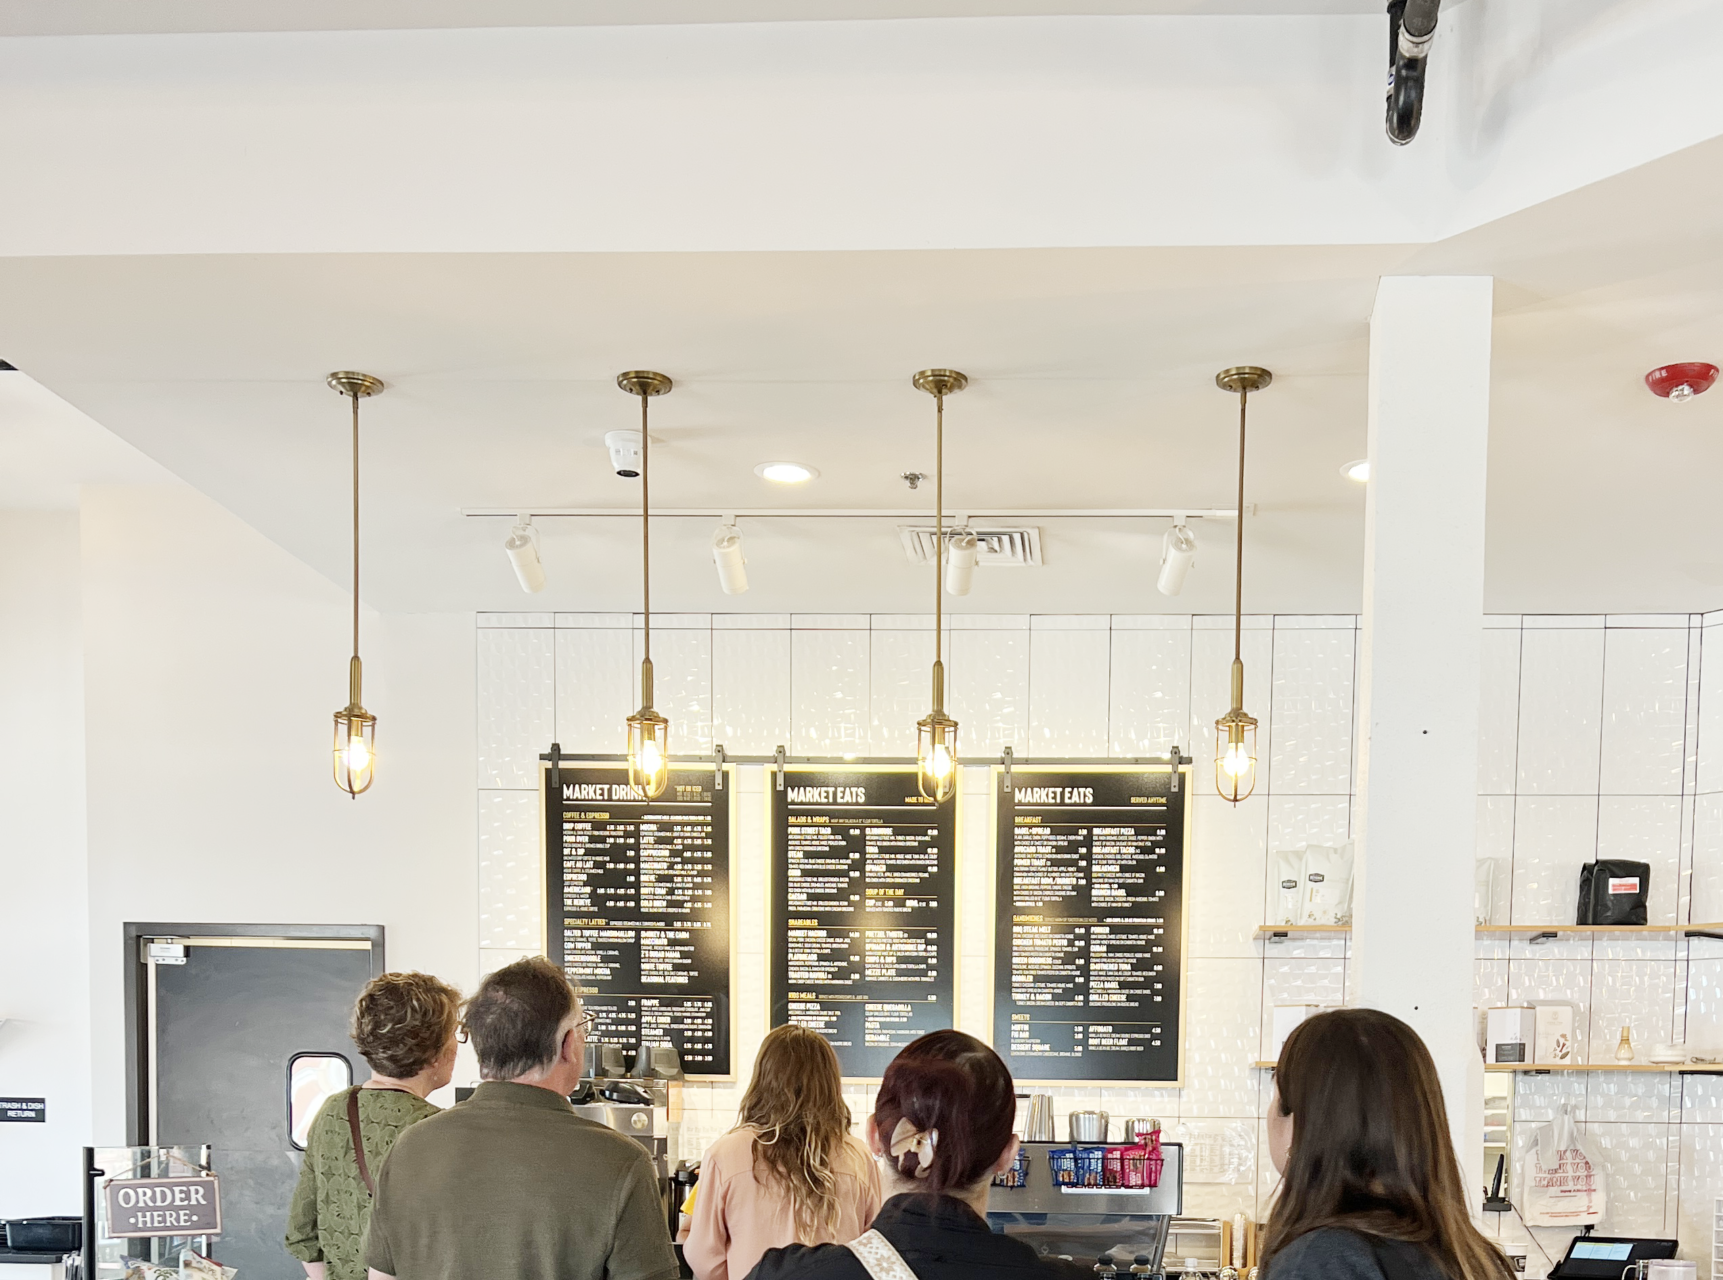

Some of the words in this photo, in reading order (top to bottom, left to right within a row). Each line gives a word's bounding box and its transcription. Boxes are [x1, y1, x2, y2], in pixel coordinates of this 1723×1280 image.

[563, 784, 609, 799] MARKET
[788, 787, 835, 802] MARKET
[837, 787, 865, 802] EATS
[1015, 788, 1062, 803] MARKET
[1064, 788, 1093, 803] EATS
[0, 1101, 21, 1109] TRASH
[1571, 1149, 1586, 1160] YO
[1534, 1176, 1569, 1187] THANK
[1572, 1175, 1595, 1186] YOU
[117, 1186, 207, 1208] ORDER
[136, 1210, 192, 1228] HERE
